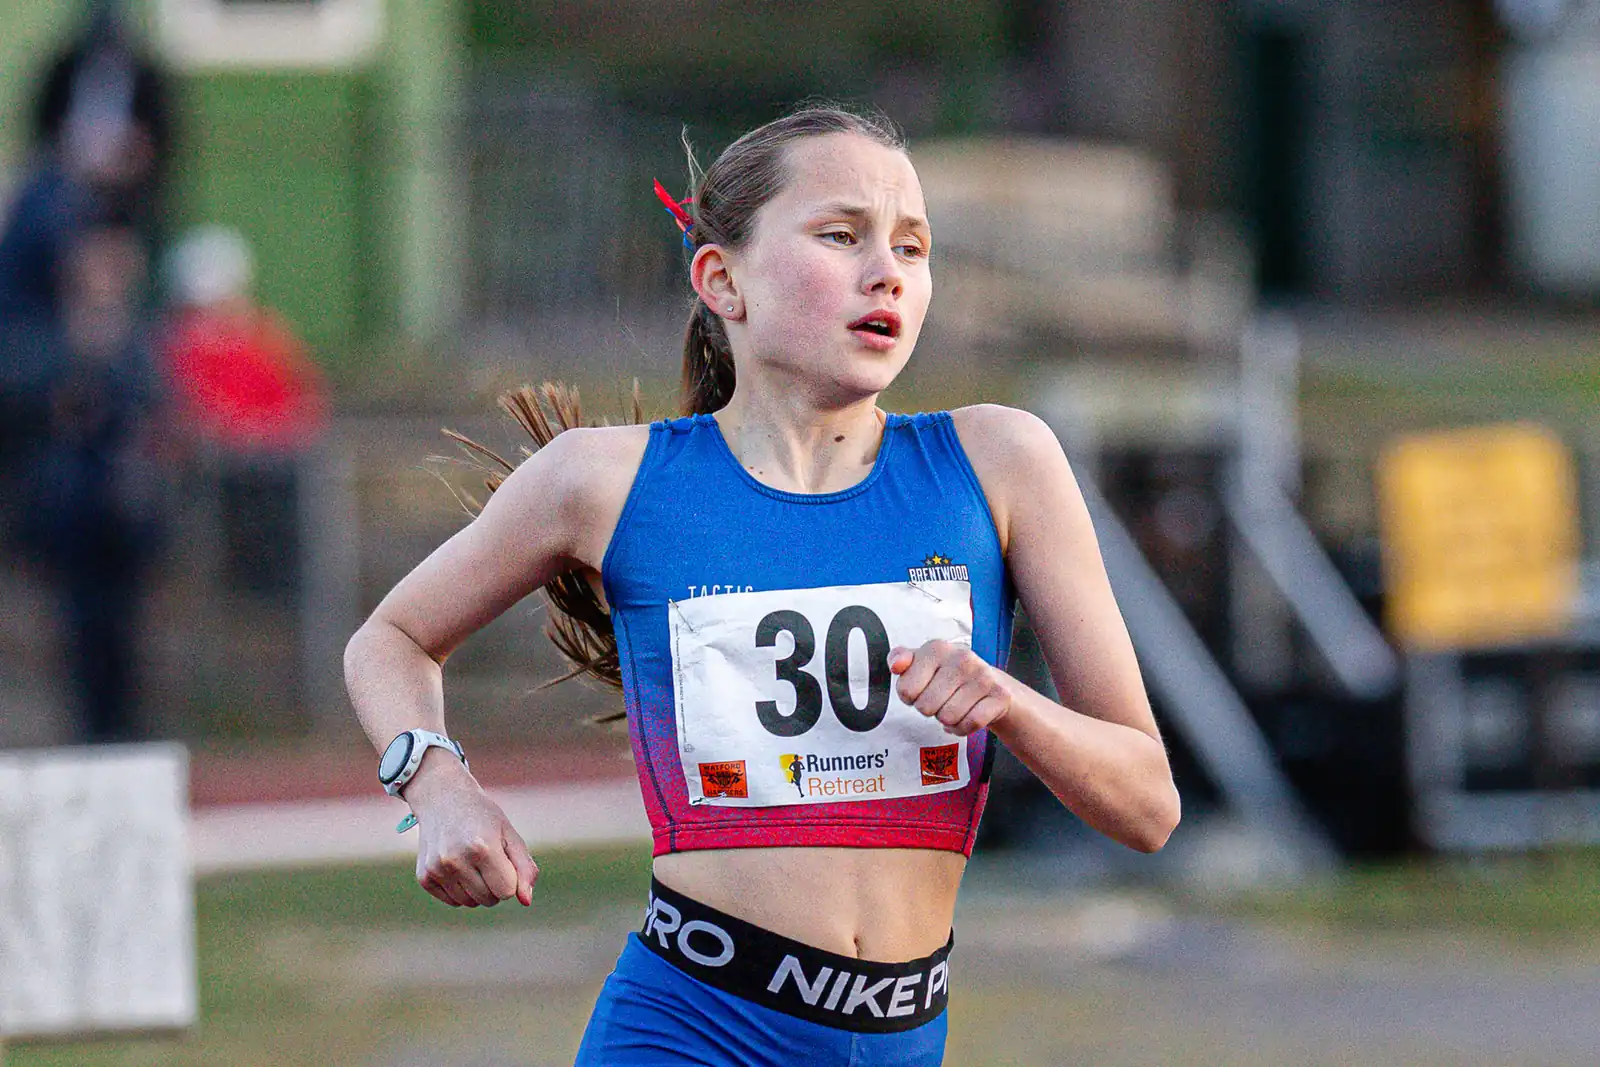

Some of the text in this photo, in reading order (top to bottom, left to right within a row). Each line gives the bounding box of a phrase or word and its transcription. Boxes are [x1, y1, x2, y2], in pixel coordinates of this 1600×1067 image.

[909, 565, 969, 582] BRENTWOOD
[755, 604, 892, 737] 30
[807, 774, 886, 796] Retreat
[766, 954, 922, 1018] NIKE
